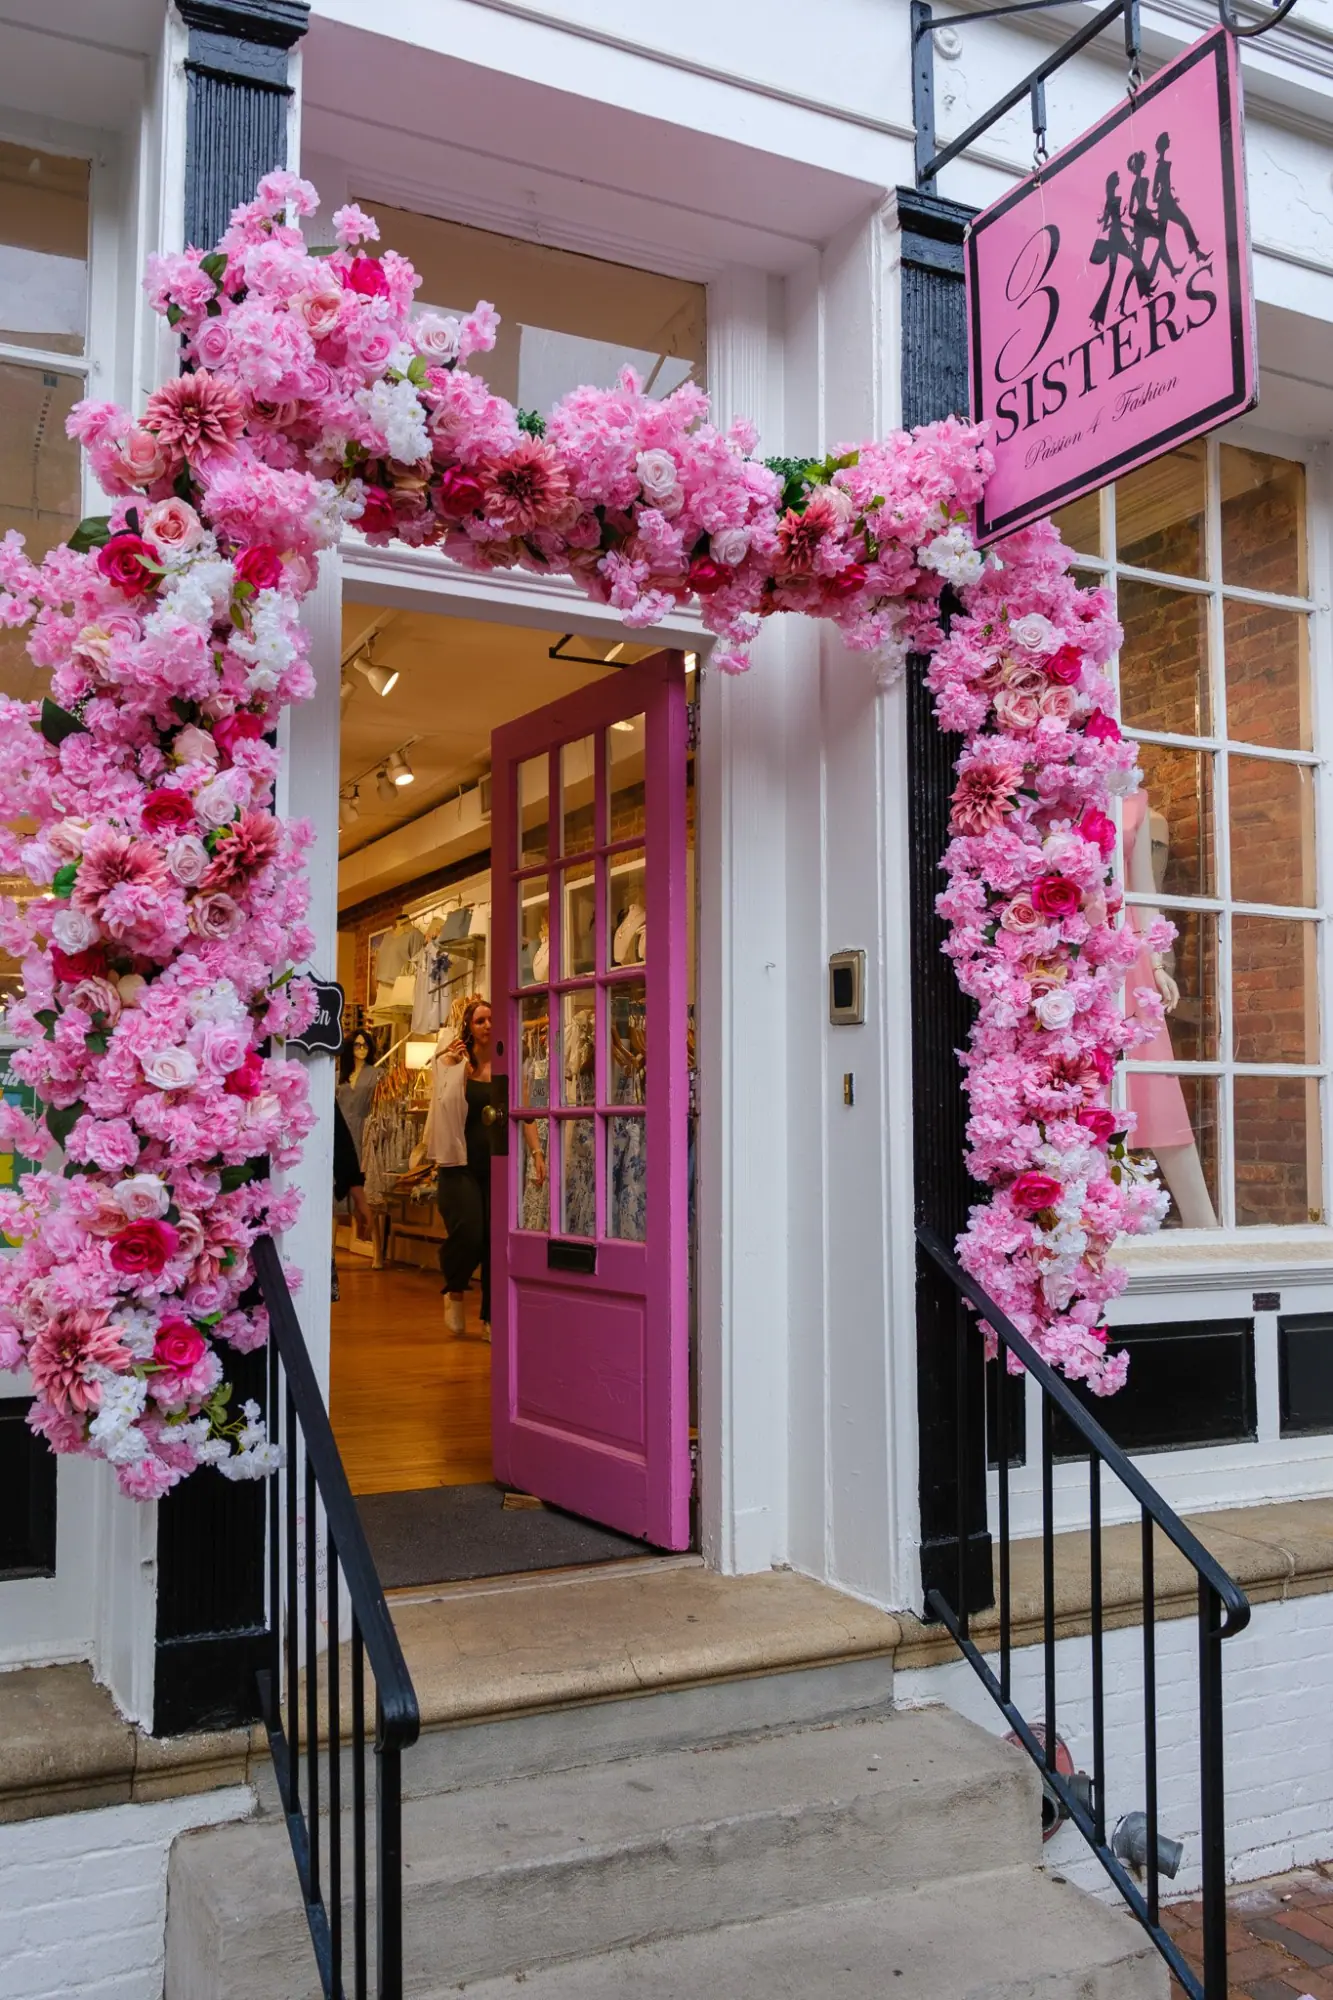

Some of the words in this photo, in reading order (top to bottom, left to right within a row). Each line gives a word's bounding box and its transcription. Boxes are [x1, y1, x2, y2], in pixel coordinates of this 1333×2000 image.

[994, 224, 1061, 383] 3
[995, 262, 1219, 447] SISTERS
[1024, 431, 1083, 470] Passion
[1086, 406, 1105, 434] 4
[1112, 376, 1180, 422] Fashion
